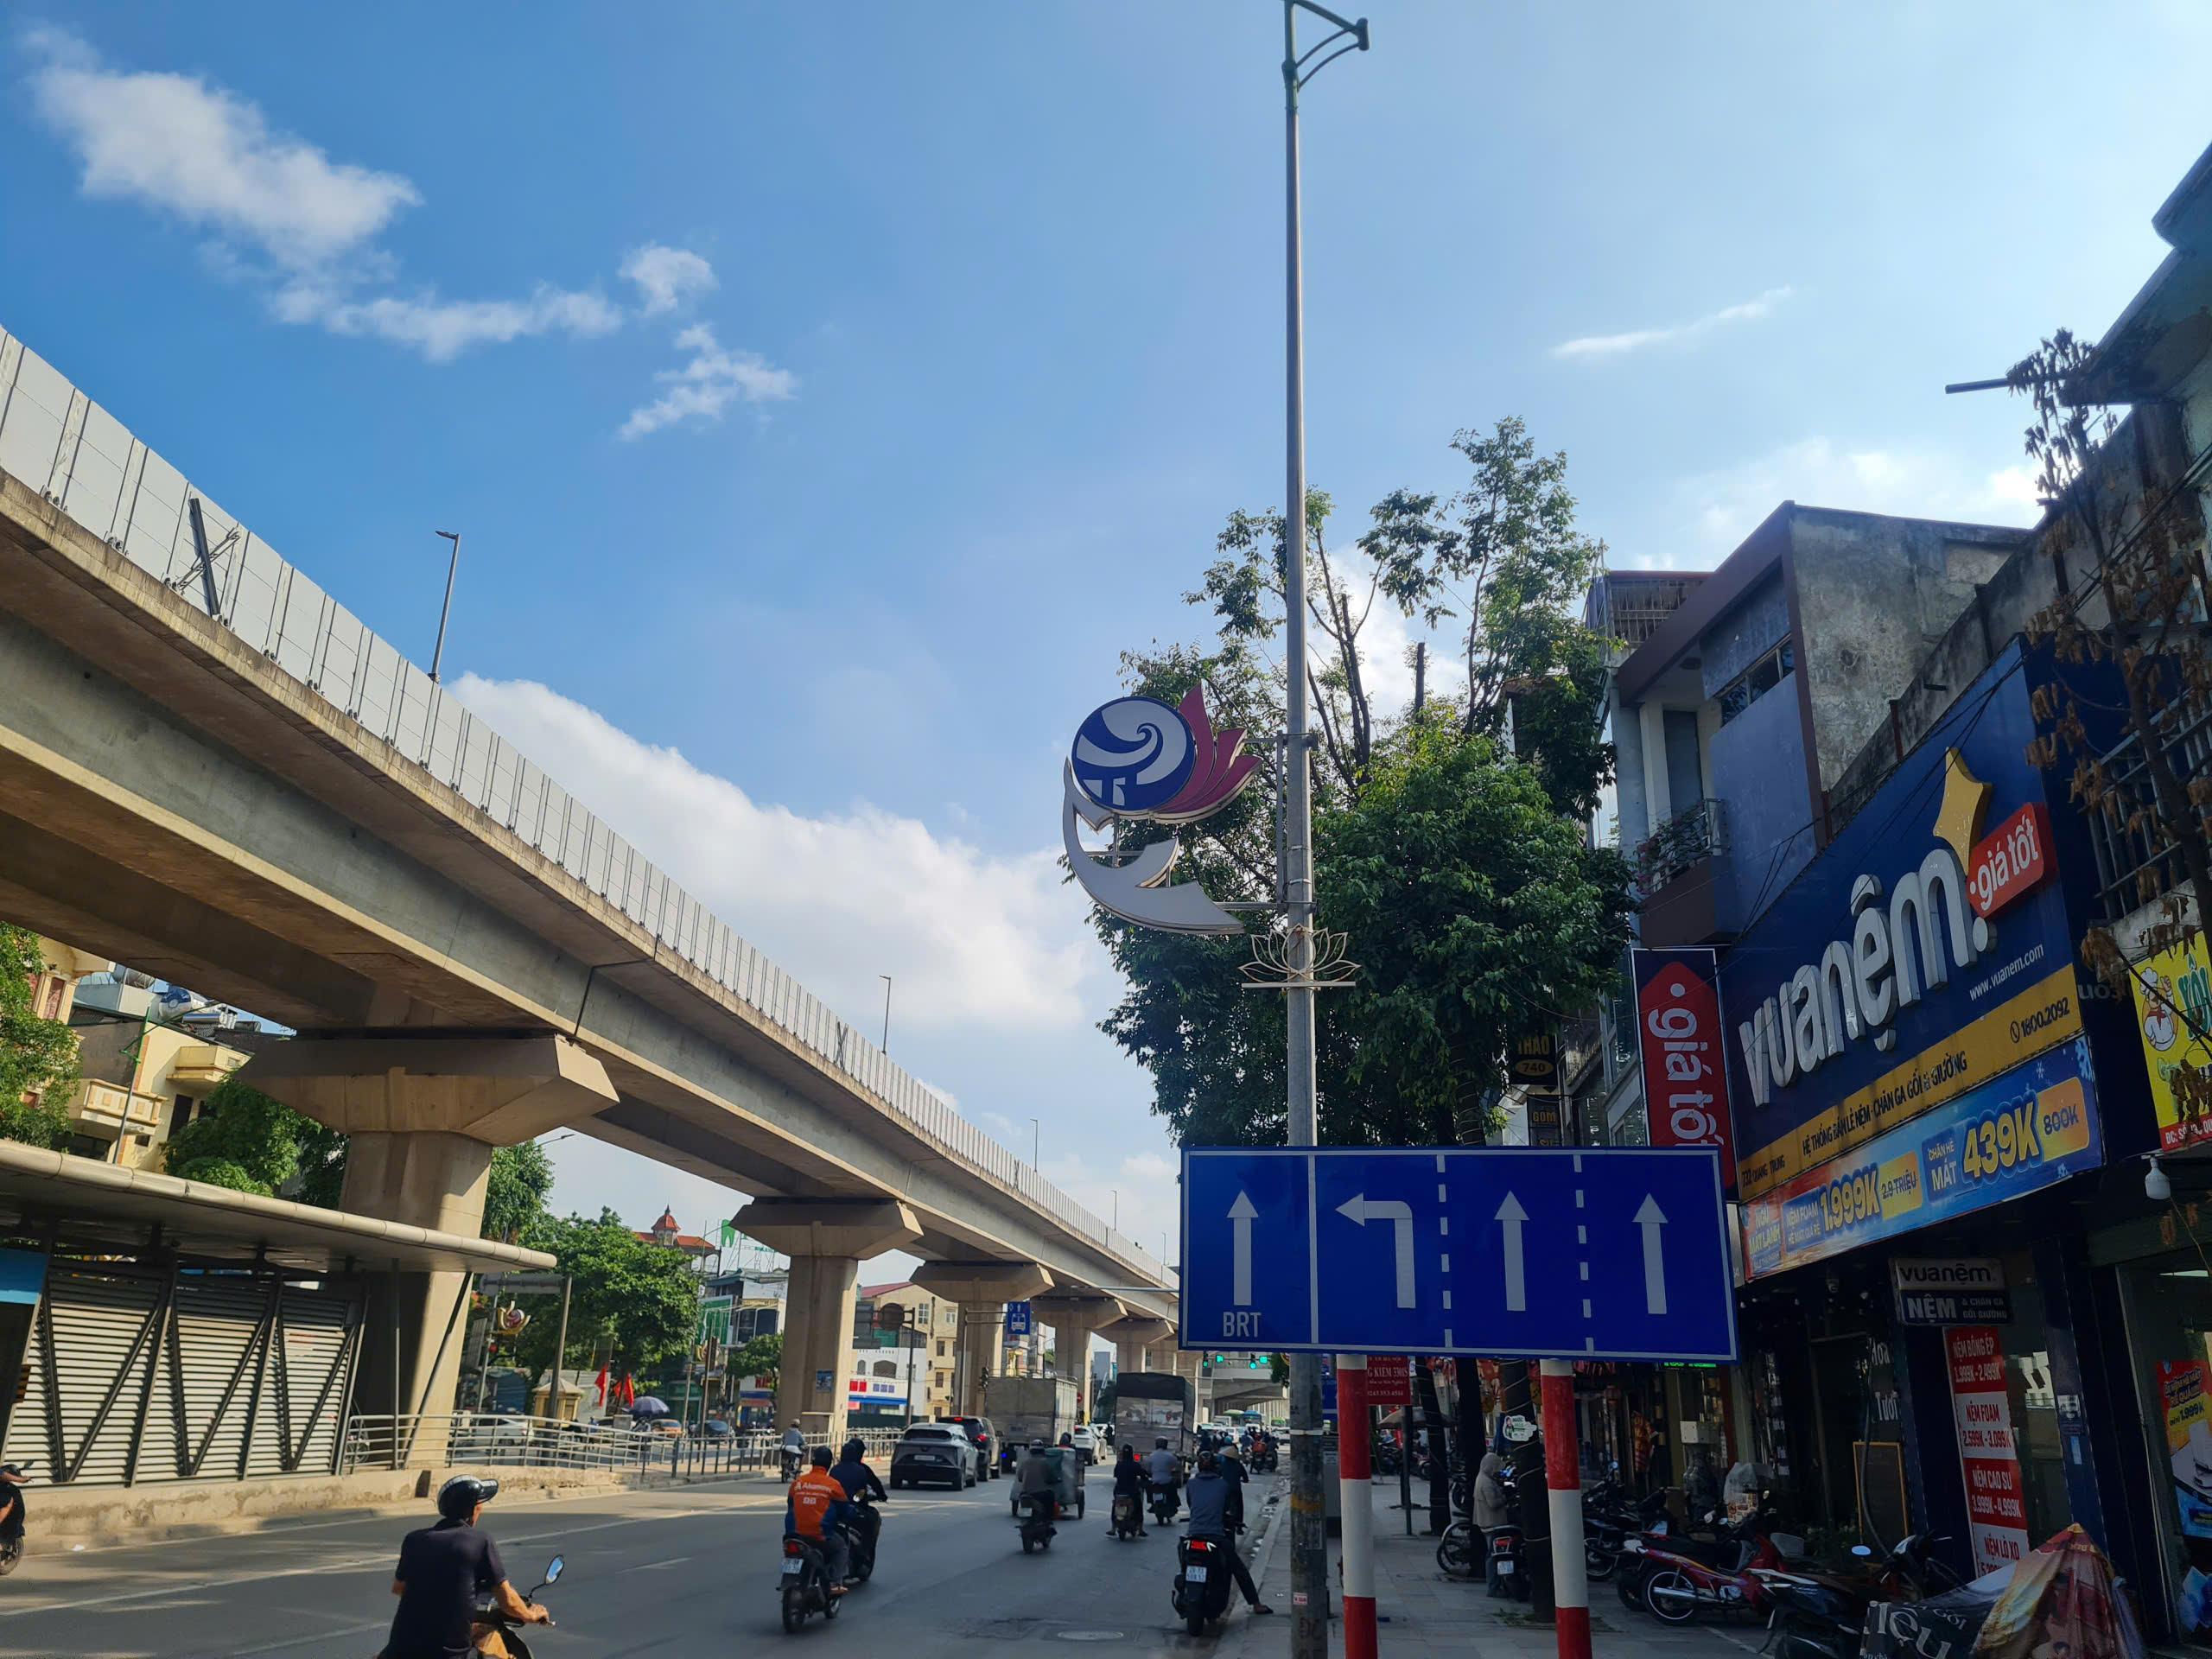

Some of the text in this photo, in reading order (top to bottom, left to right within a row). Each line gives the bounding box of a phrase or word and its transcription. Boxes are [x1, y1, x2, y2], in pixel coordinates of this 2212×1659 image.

[1977, 816, 2040, 910] giá tốt
[1969, 944, 2044, 1001] www.vuanem.com
[2021, 997, 2070, 1038] 1800.2092
[1522, 1063, 1546, 1073] 740
[1648, 1007, 1725, 1147] giá tố
[1802, 1135, 1812, 1158] HỆ
[1811, 1123, 1833, 1150] THỐNG
[1847, 1108, 1855, 1132] LẺ
[1855, 1103, 1871, 1130] NỆM
[1894, 1085, 1907, 1106] GA
[1907, 1068, 1923, 1099] GỐI
[1930, 1050, 1967, 1086] GIƯỜNG
[2043, 1105, 2079, 1135] 800K
[1963, 1102, 2040, 1179] 439K
[1931, 1155, 1957, 1192] MÁT
[1820, 1170, 1880, 1231] 1.999K
[1907, 1294, 1957, 1323] NỆM
[1224, 1312, 1262, 1338] BRT
[1966, 1401, 1999, 1426] NỆM FOAM
[1962, 1430, 1985, 1447] 2.599K
[1988, 1430, 2012, 1448] 3.099K
[1972, 1465, 2012, 1491] NỆM CAO SU
[1972, 1494, 1994, 1514] 3.999K
[1998, 1497, 2022, 1518] 4.999K
[1984, 1534, 2020, 1560] NỆM LÒ XO
